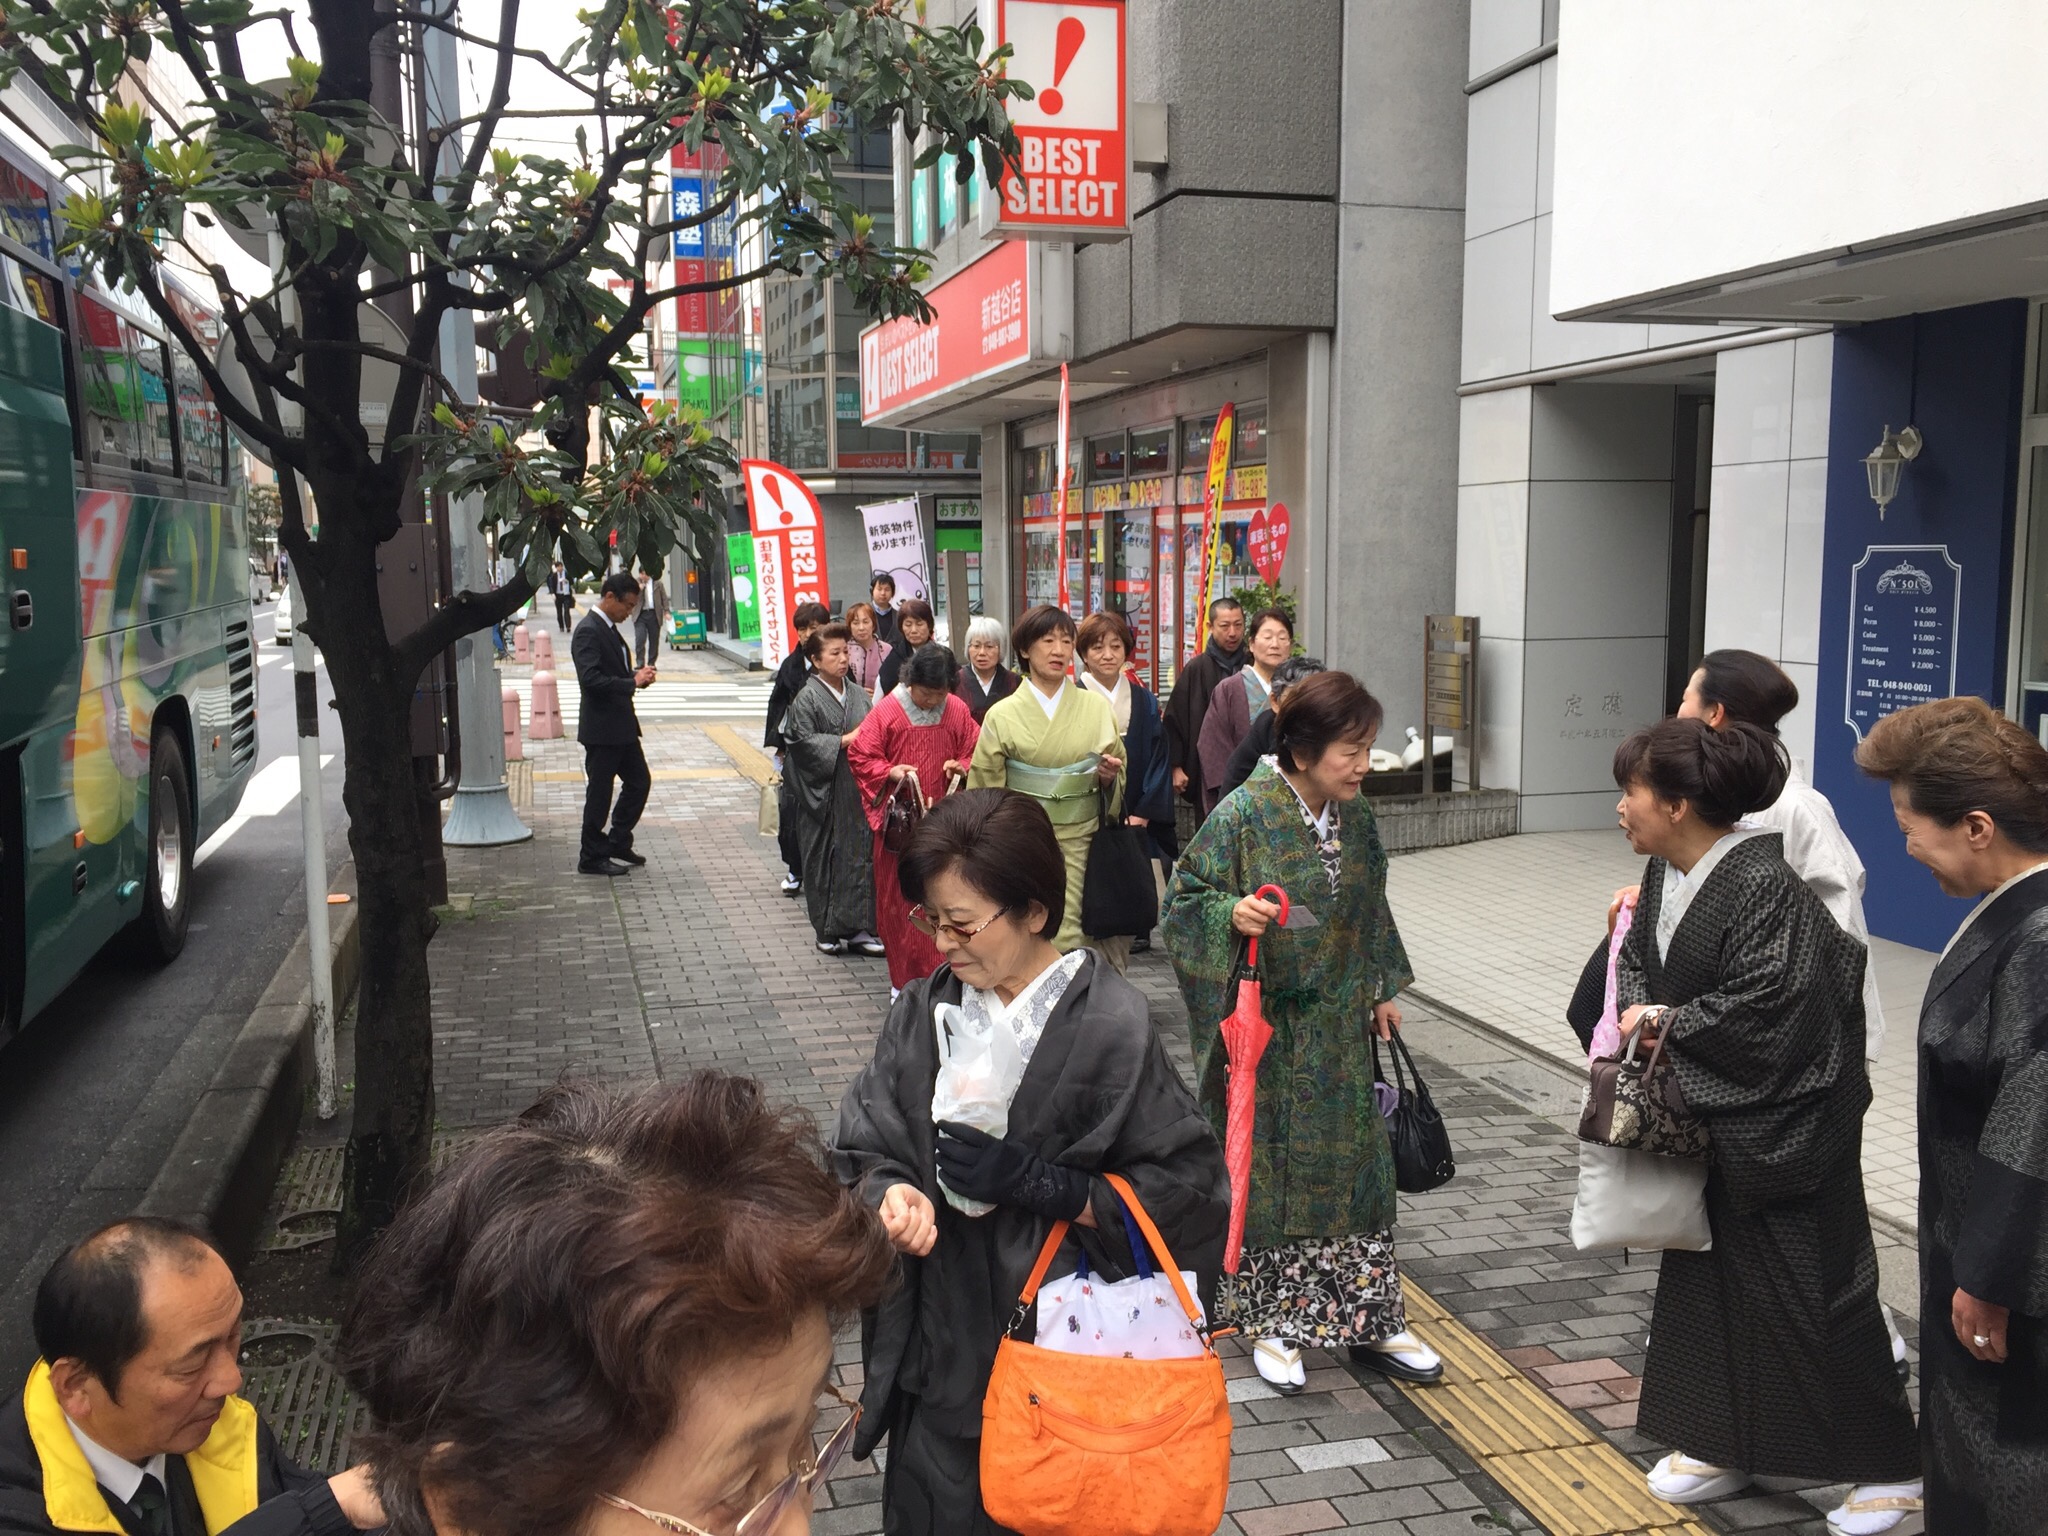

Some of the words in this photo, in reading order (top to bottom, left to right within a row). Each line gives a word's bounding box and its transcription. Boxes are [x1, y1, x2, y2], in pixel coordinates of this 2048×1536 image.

[1022, 136, 1102, 176] BEST
[1006, 176, 1118, 217] SELECT
[881, 346, 902, 400] BEST
[904, 325, 939, 391] SELECT
[869, 520, 914, 537] 新築物件
[872, 535, 915, 551] あります!!
[1864, 604, 1874, 612] Cut
[1862, 631, 1877, 639] Color
[1862, 644, 1889, 653] Treatment
[1876, 659, 1886, 667] Spa
